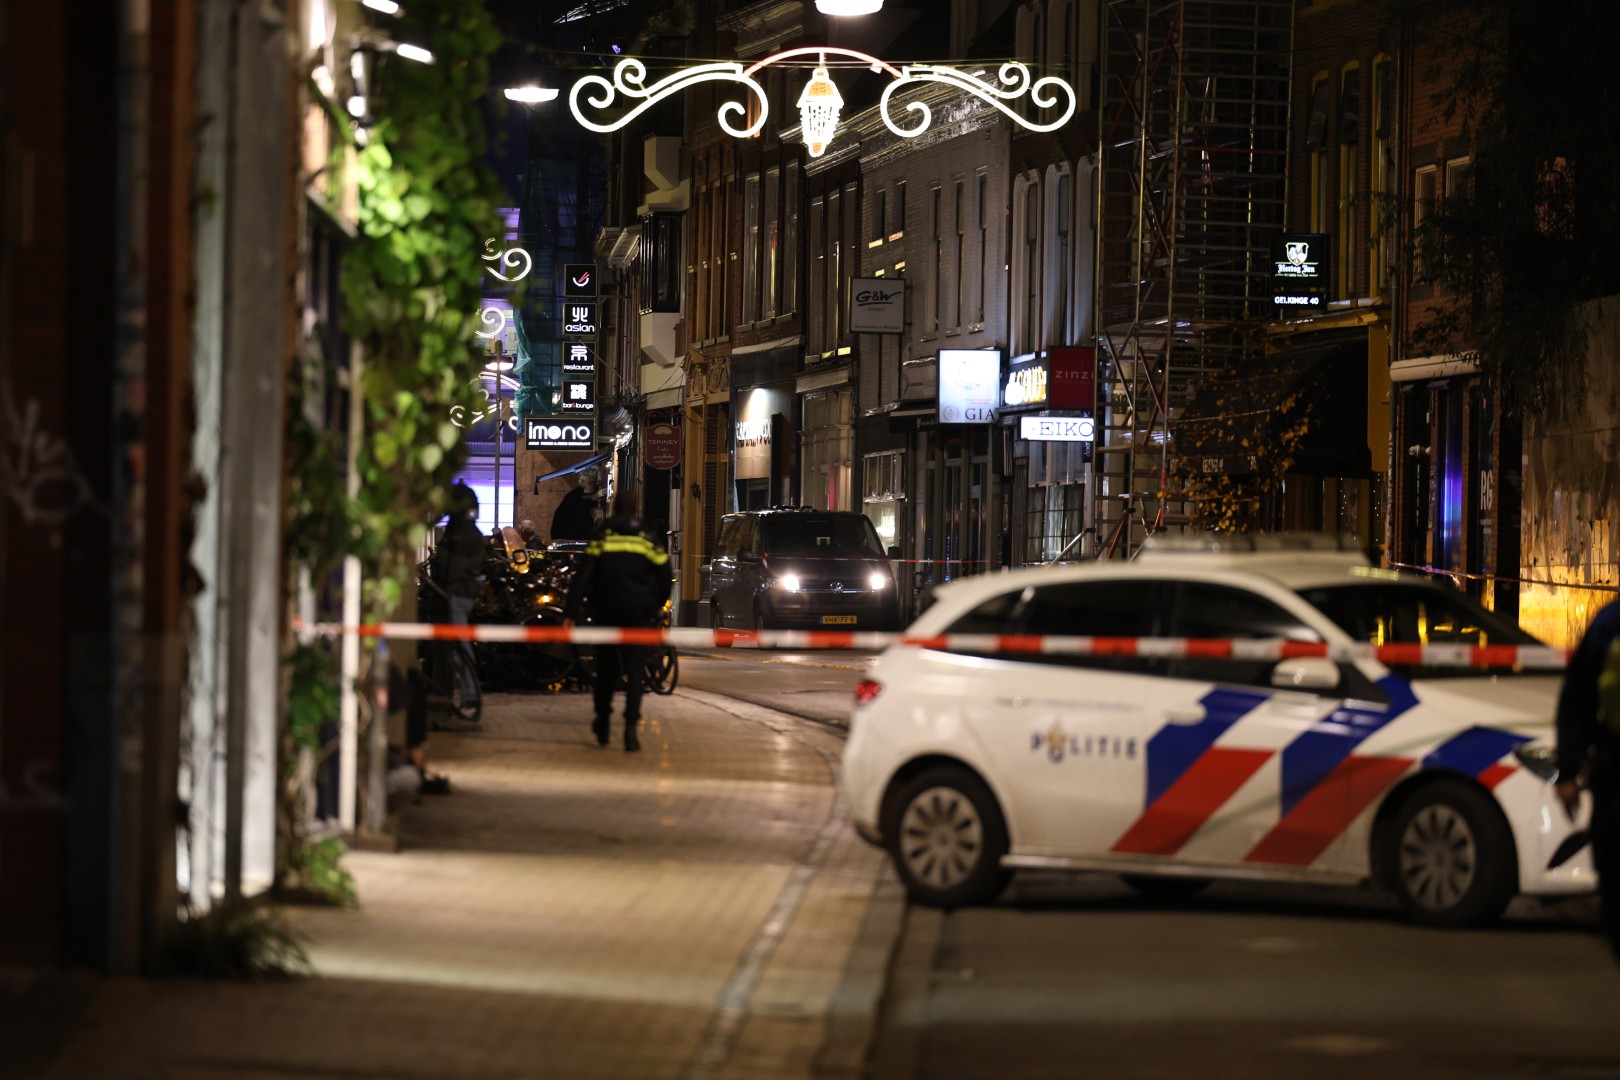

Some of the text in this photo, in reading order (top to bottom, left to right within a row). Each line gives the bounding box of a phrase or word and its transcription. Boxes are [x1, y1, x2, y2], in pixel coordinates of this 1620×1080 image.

[1309, 297, 1319, 305] 40
[565, 323, 595, 332] asian
[563, 363, 594, 371] restaurant
[964, 408, 995, 421] GIA
[528, 421, 591, 440] imono
[1032, 421, 1094, 437] EIKO
[1031, 732, 1137, 763] POLITIE
